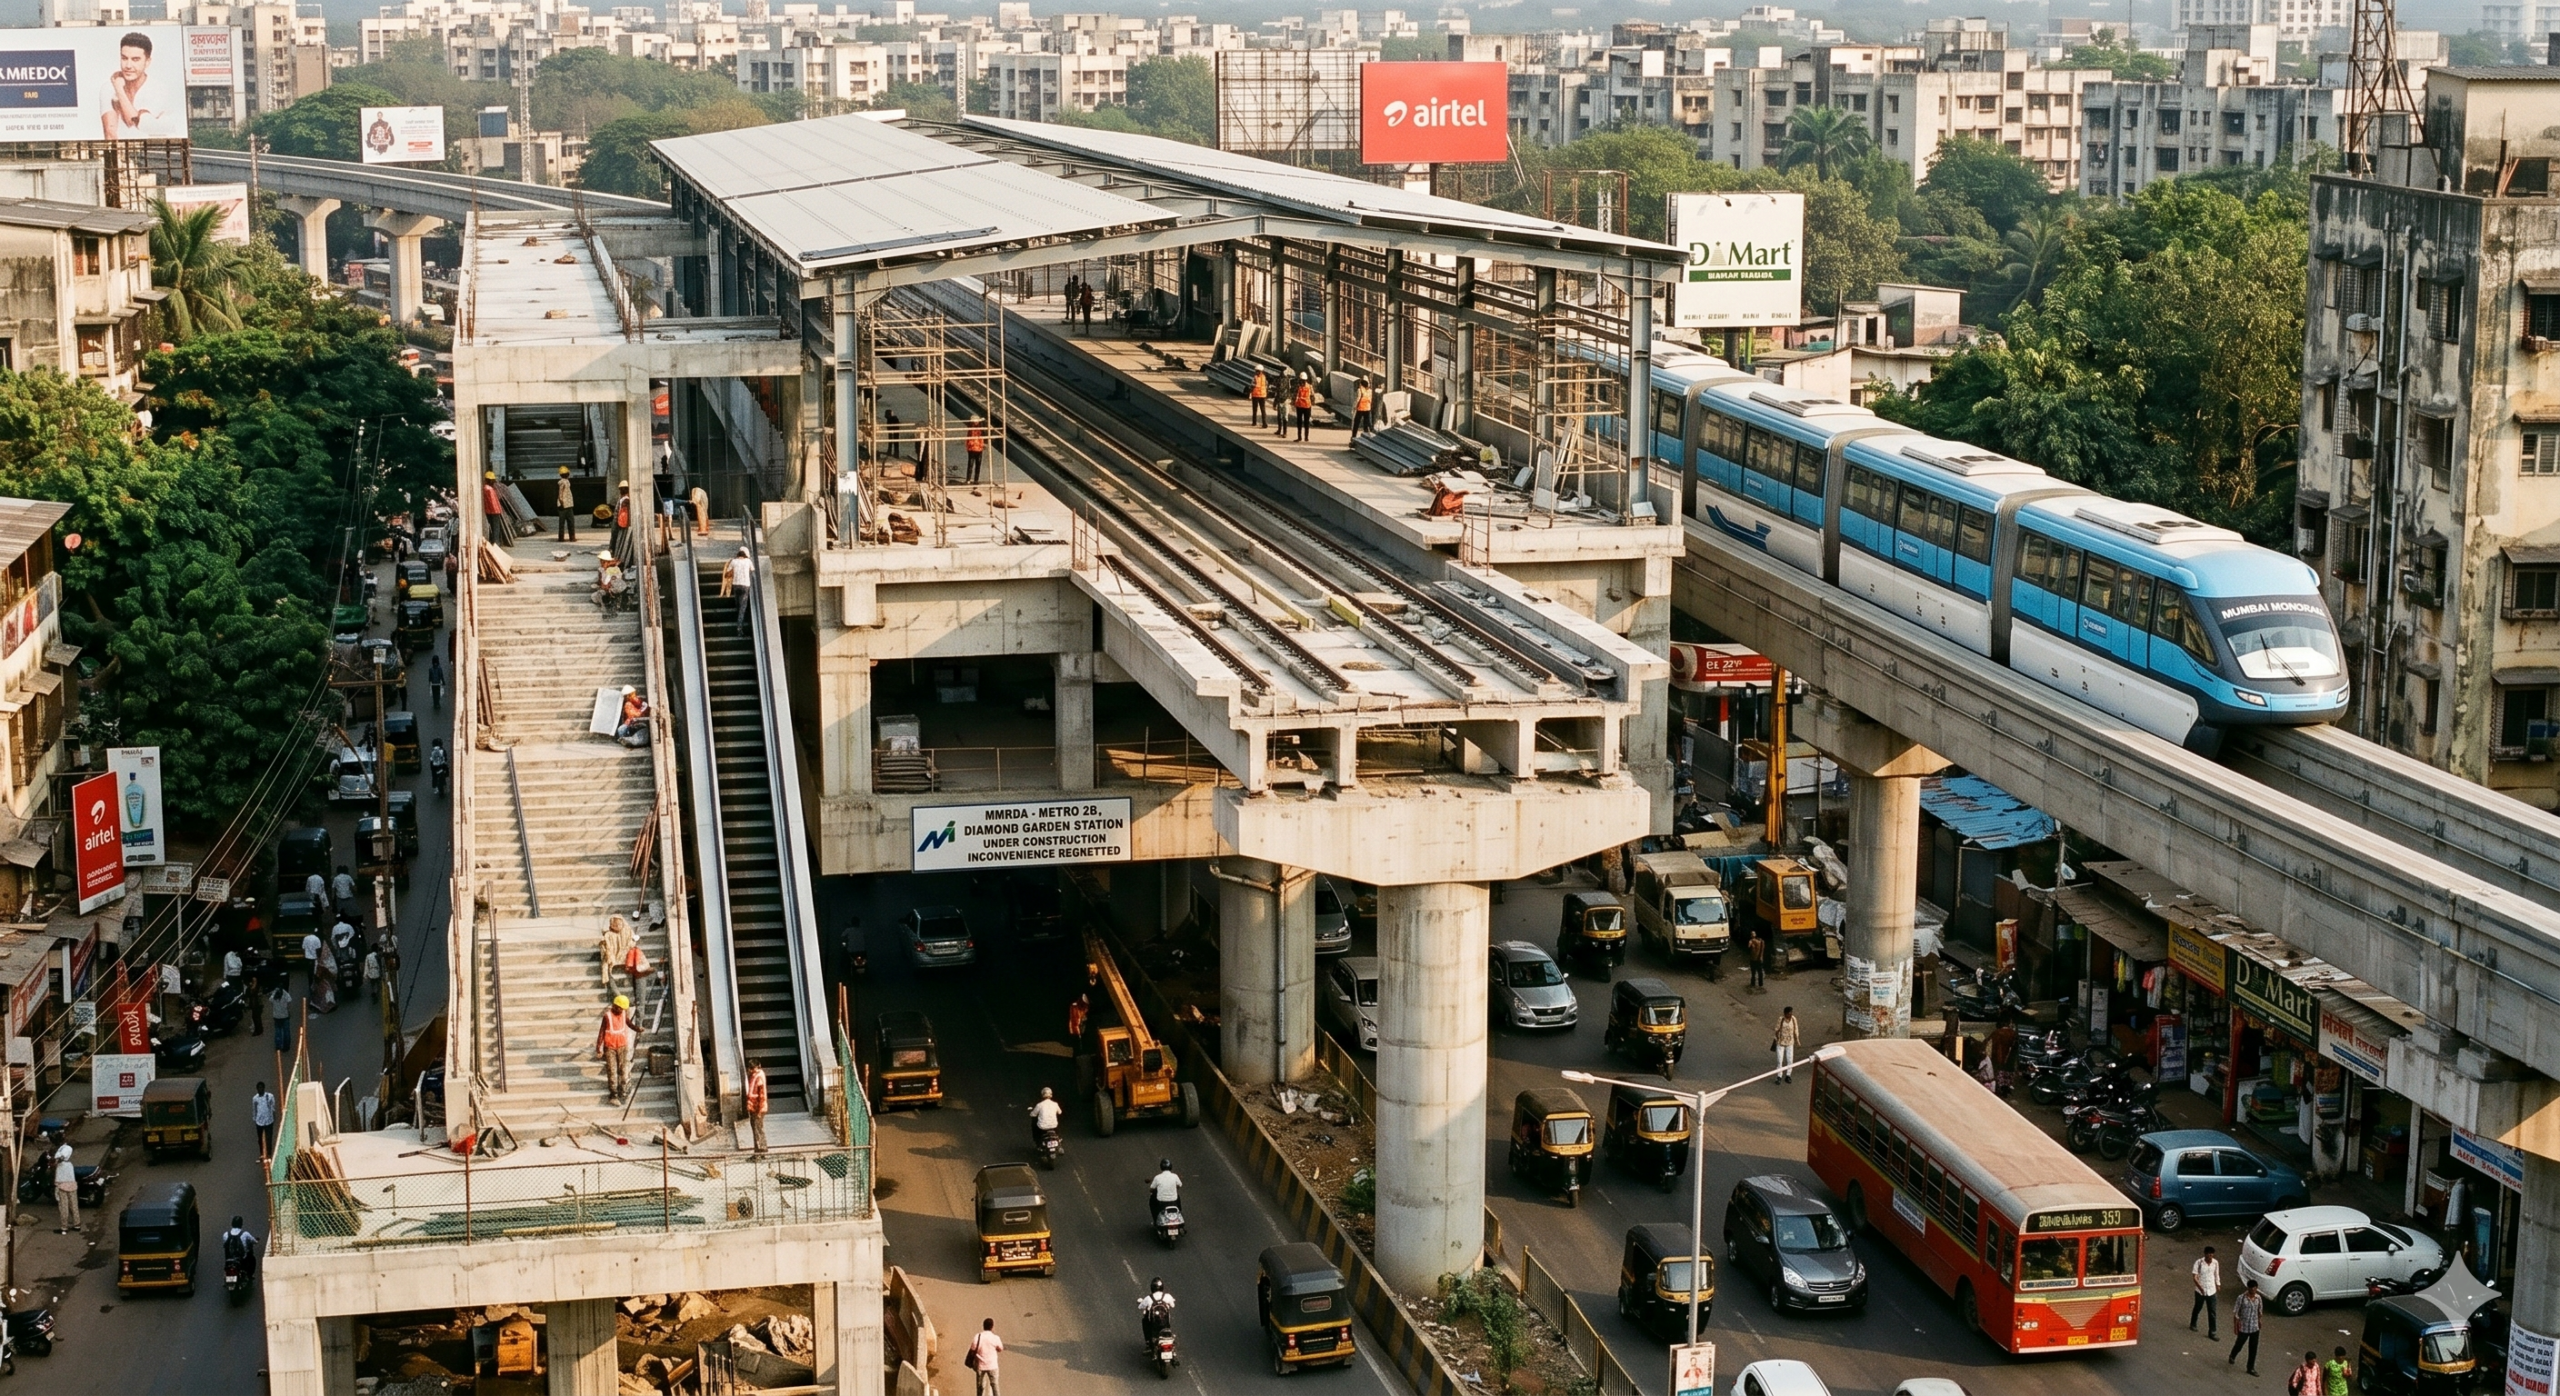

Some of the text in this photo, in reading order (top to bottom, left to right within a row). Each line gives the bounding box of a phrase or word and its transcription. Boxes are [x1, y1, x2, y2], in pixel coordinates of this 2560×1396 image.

[1413, 96, 1488, 127] airtel
[2221, 603, 2270, 619] MUMBAI
[985, 808, 1030, 820] MMRDA
[1038, 806, 1079, 818] METRO
[1082, 805, 1102, 817] 2B,
[1022, 820, 1070, 833] GARDEN
[1074, 818, 1124, 831] STATION
[85, 825, 115, 851] airtel
[983, 834, 1107, 849] UNDER CONSTRUCTION
[967, 848, 1055, 862] INCONVENIENCE
